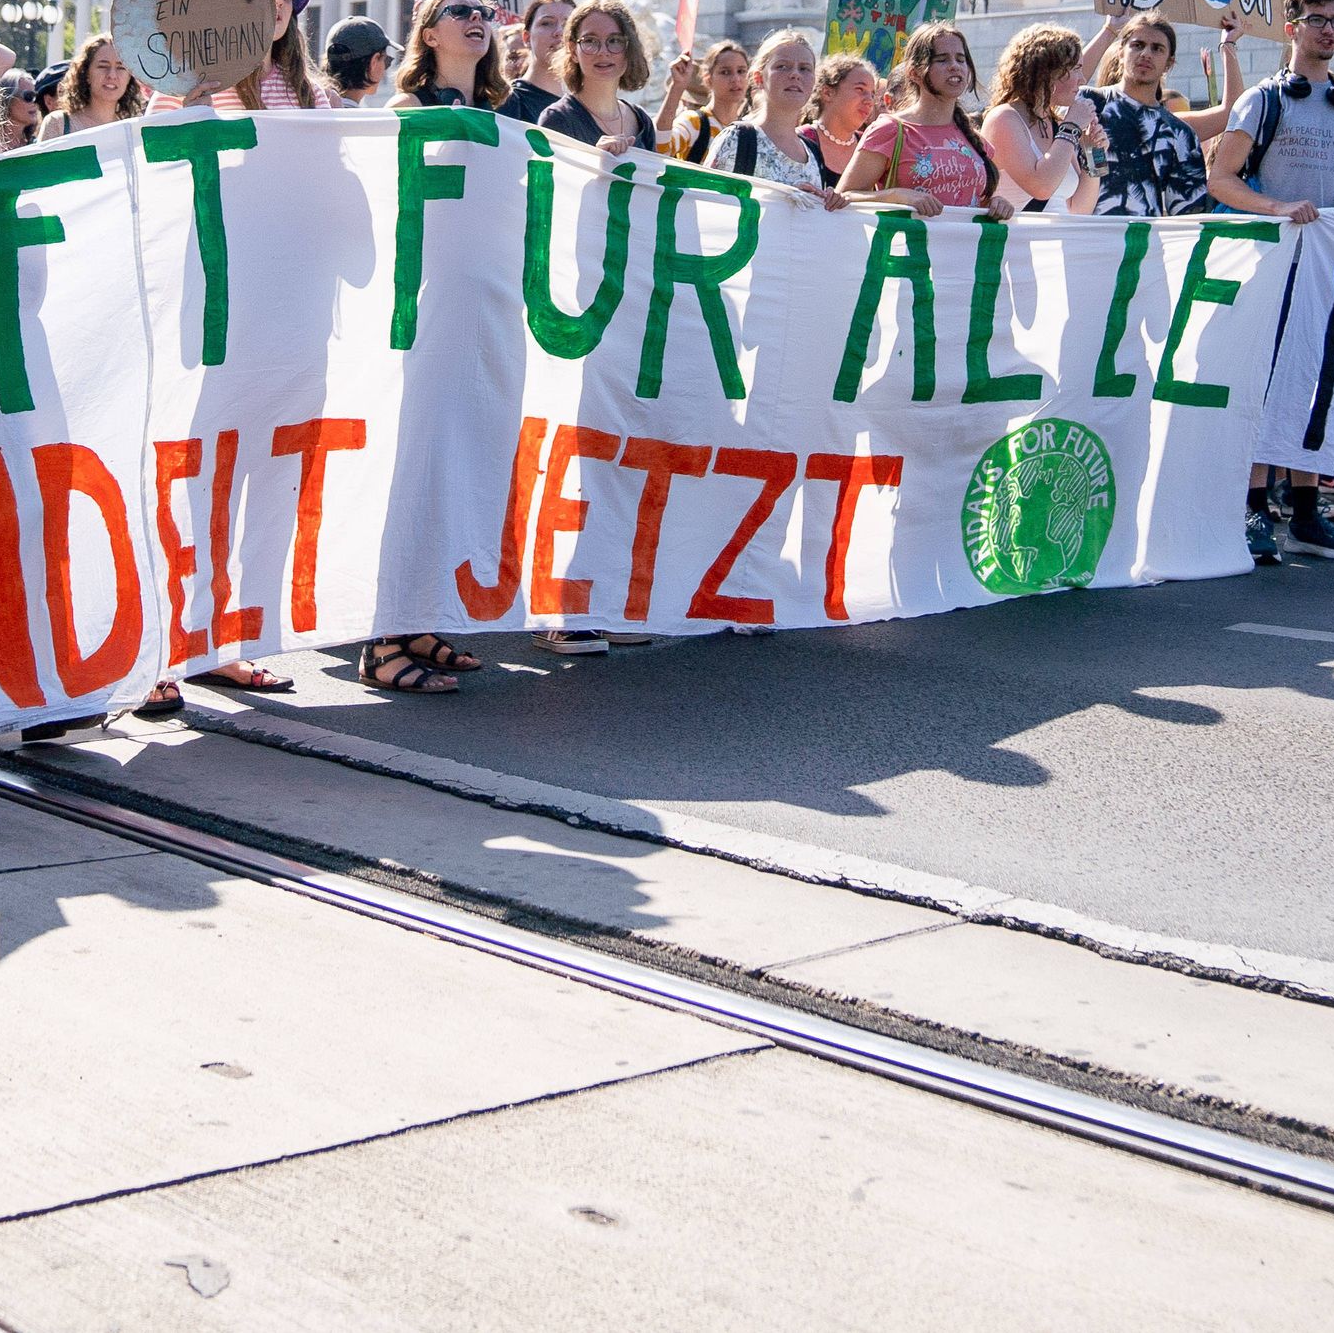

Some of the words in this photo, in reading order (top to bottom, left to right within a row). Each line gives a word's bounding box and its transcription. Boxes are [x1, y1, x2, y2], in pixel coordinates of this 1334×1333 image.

[137, 21, 265, 80] SCHNEEMANN
[1279, 137, 1287, 146] IS
[1289, 137, 1318, 148] BACKED
[1321, 140, 1331, 149] BY
[1296, 127, 1333, 138] PEACEFUL
[932, 155, 967, 180] Hello
[1302, 149, 1328, 160] NUKES
[389, 106, 760, 401] FÜR
[833, 206, 1281, 407] ALLE
[455, 416, 903, 623] JETZT
[967, 460, 1004, 582] FRIDAYS
[1008, 423, 1056, 464] FOR
[1061, 427, 1109, 511] FUTURE
